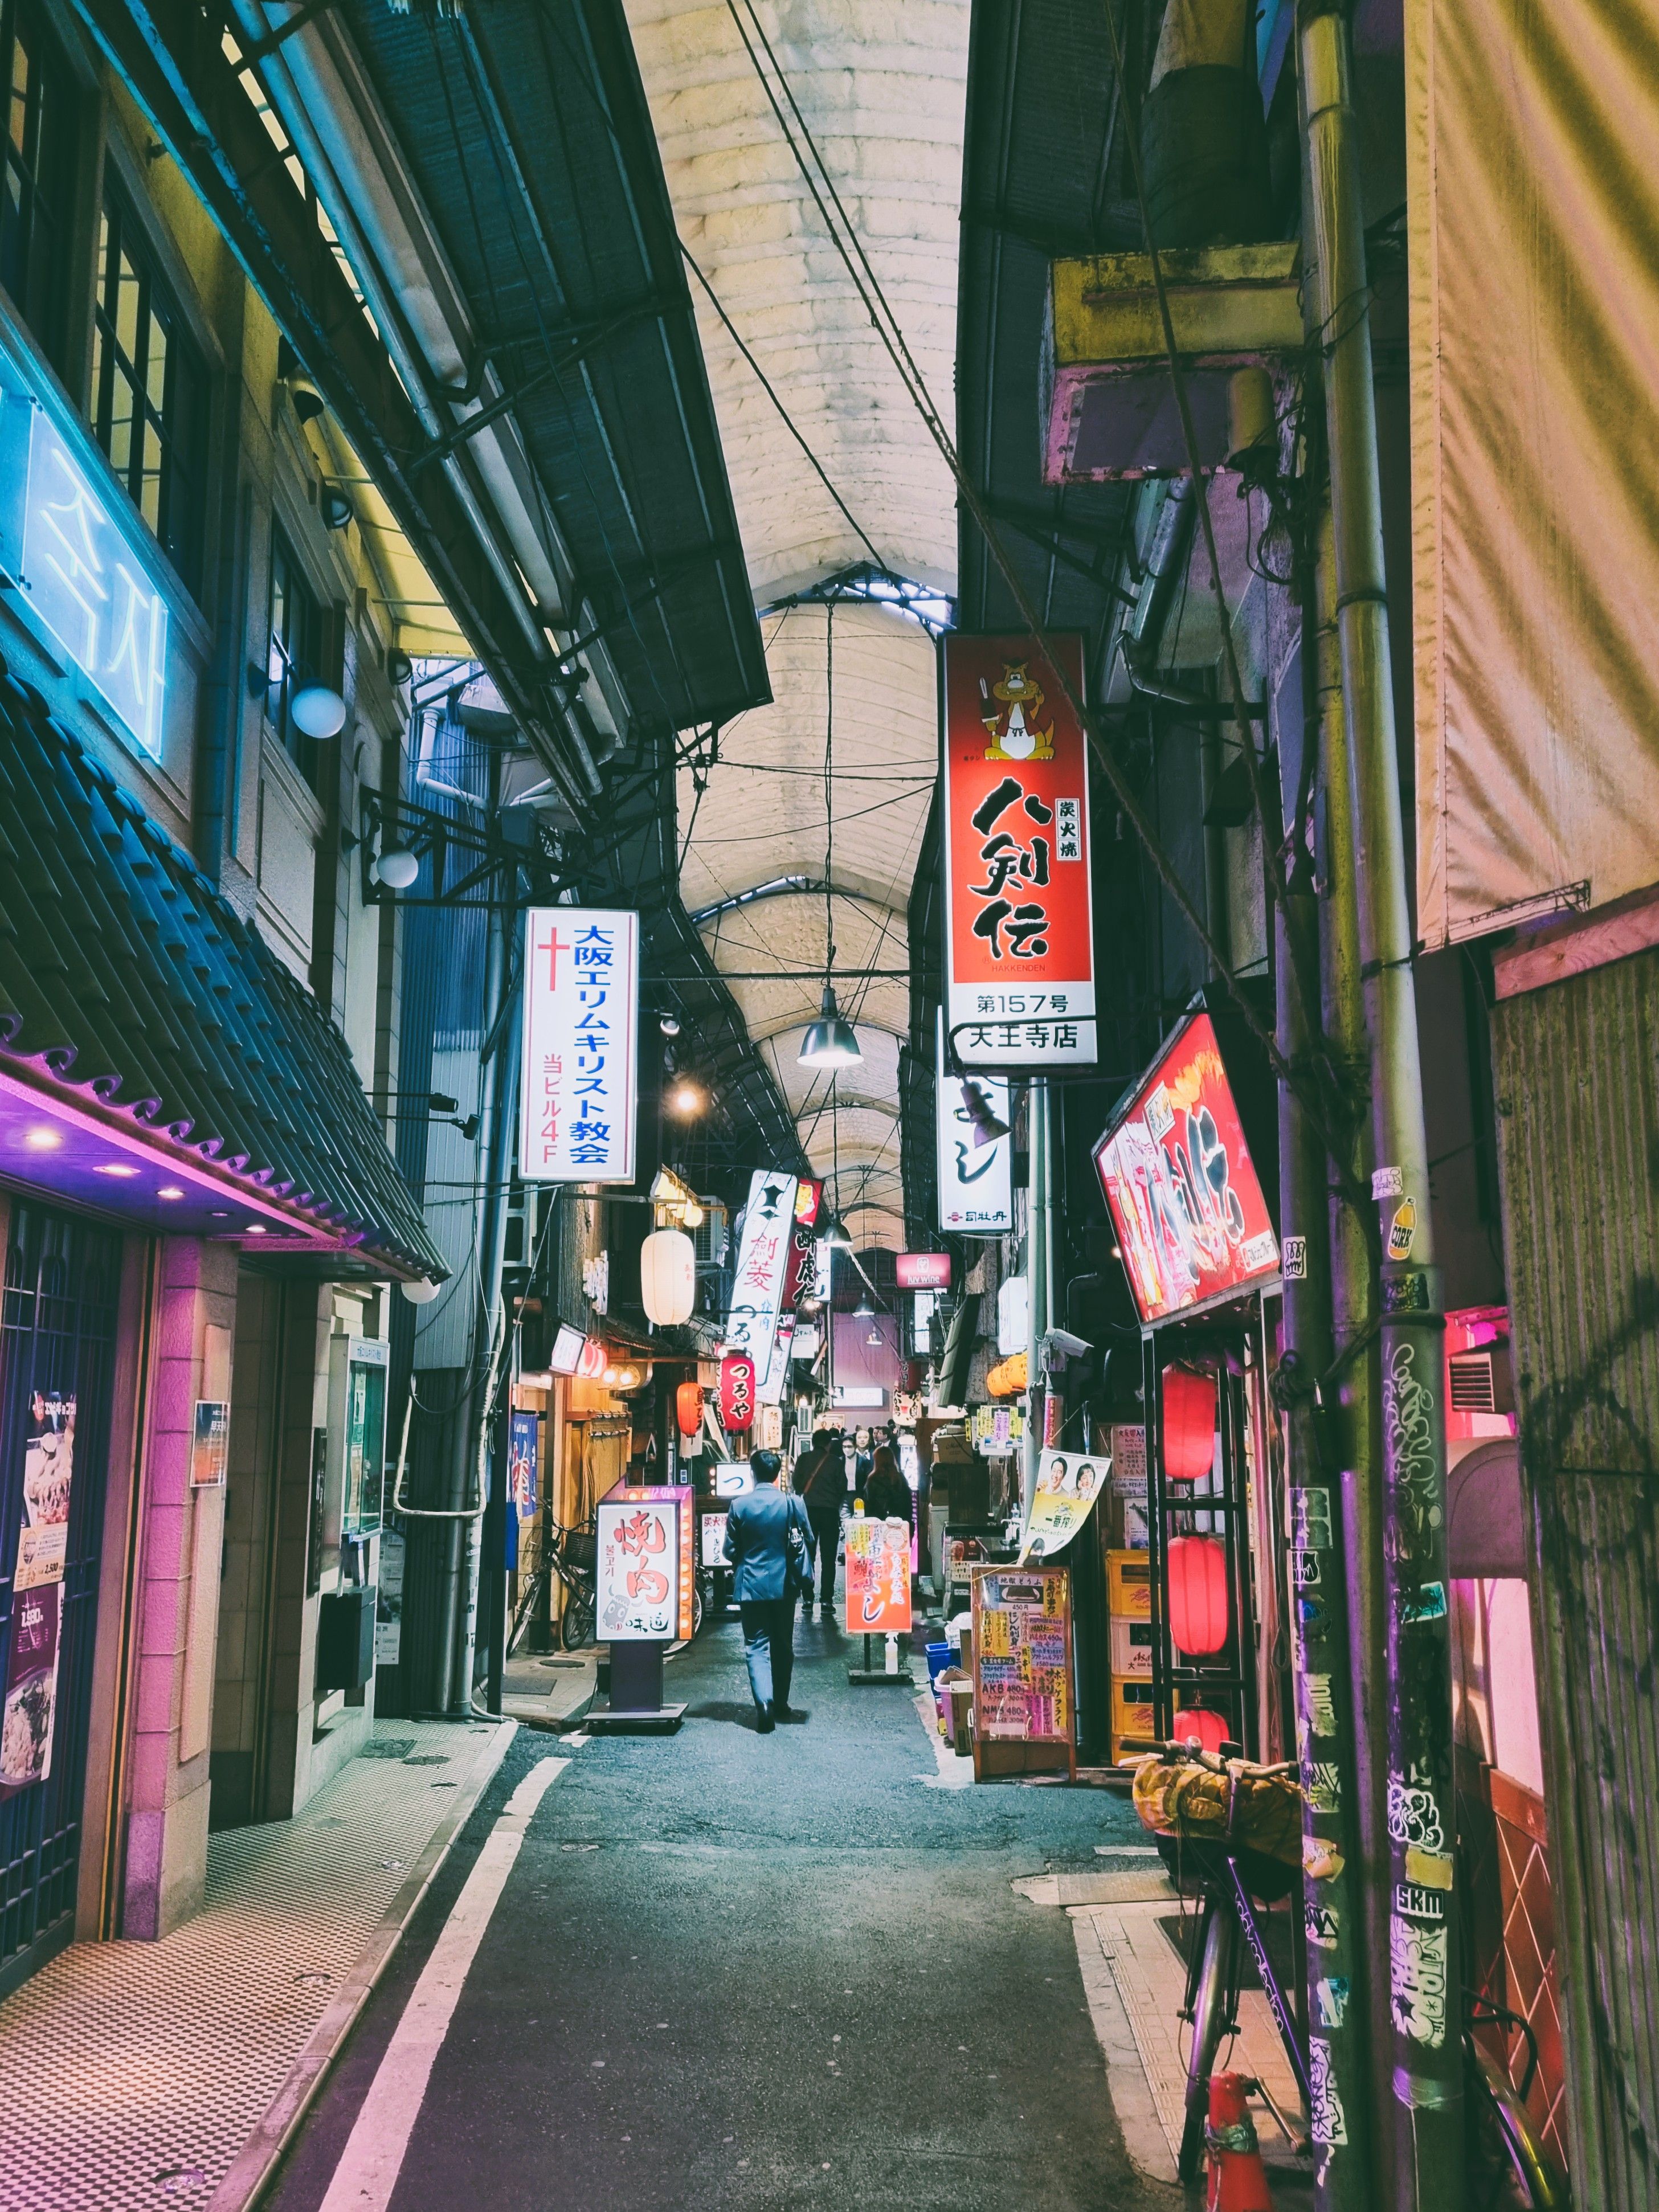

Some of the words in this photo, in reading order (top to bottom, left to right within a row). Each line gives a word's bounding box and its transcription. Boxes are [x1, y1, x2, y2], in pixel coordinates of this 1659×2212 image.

[1059, 800, 1078, 858] 炭火焼
[968, 776, 1054, 959] 八剣伝
[991, 963, 1045, 972] HAKKENDEN
[977, 994, 1069, 1013] 第157号
[569, 925, 614, 1164] 大阪エリムキリスト教会
[970, 1024, 1078, 1049] 天王寺店
[966, 1211, 1007, 1222] 司牡丹
[908, 1274, 921, 1284] luv
[921, 1274, 940, 1283] wine
[730, 1364, 750, 1418] つるや
[1045, 1515, 1077, 1529] 一番搾り
[605, 1544, 615, 1577] 불고기
[614, 1510, 669, 1604] 焼肉
[982, 1684, 1004, 1694] AKB
[1398, 1885, 1443, 1916] SKM
